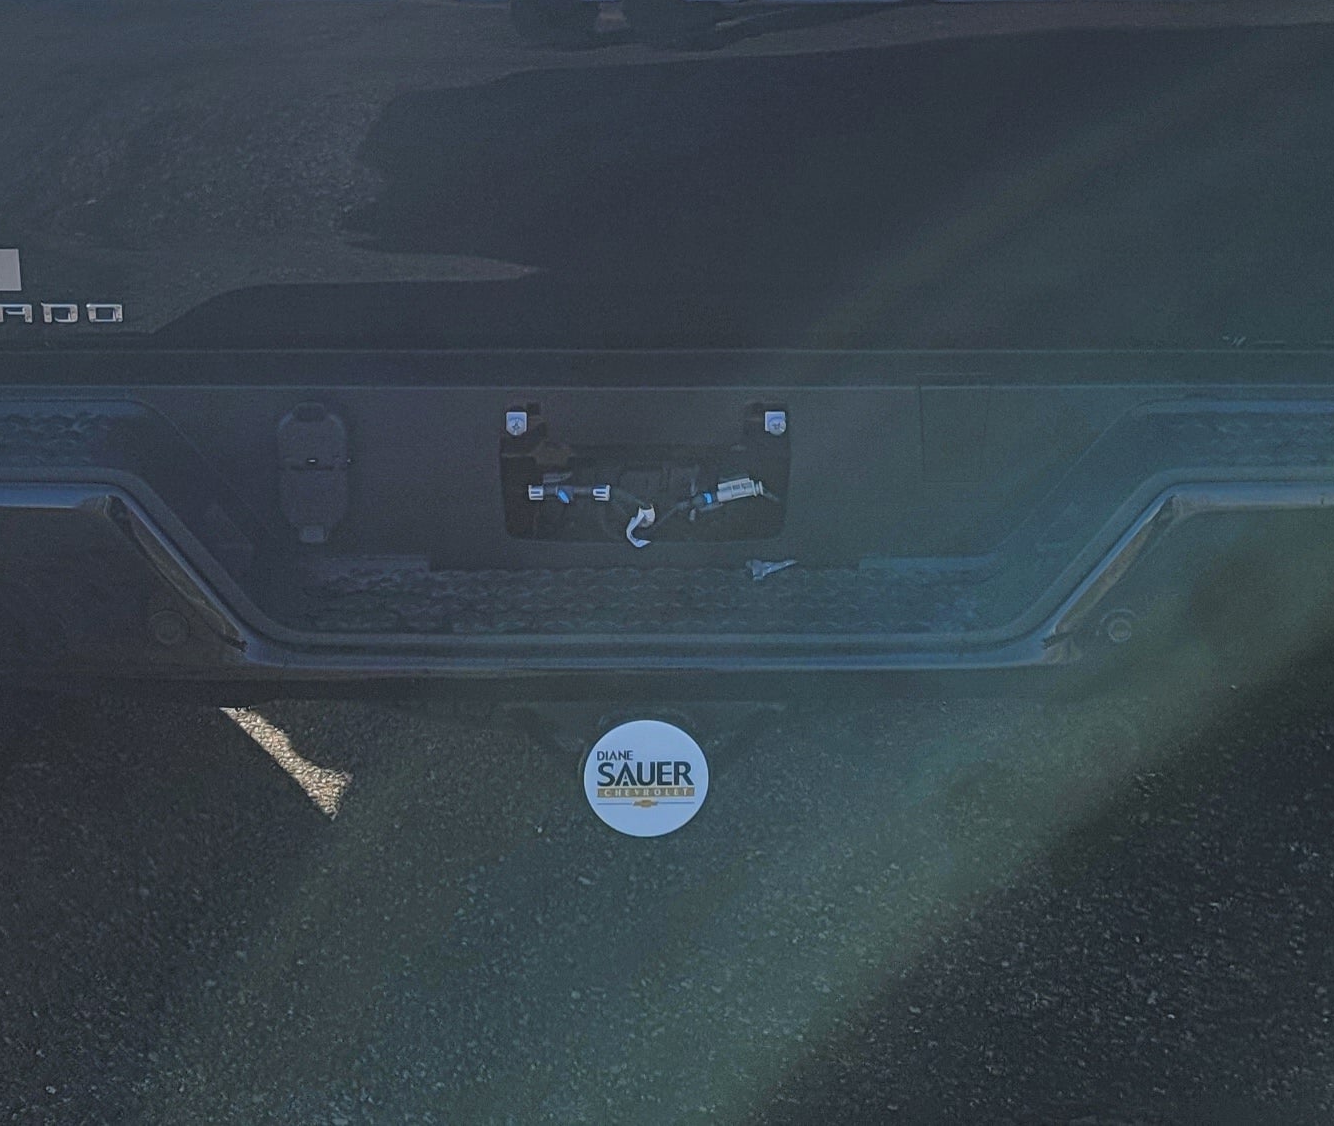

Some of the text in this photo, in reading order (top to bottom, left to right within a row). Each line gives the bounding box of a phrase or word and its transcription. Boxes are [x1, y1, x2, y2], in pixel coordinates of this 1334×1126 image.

[596, 750, 633, 760] DIANE
[597, 761, 694, 787] SAUER
[603, 788, 689, 797] CHEVROLET
